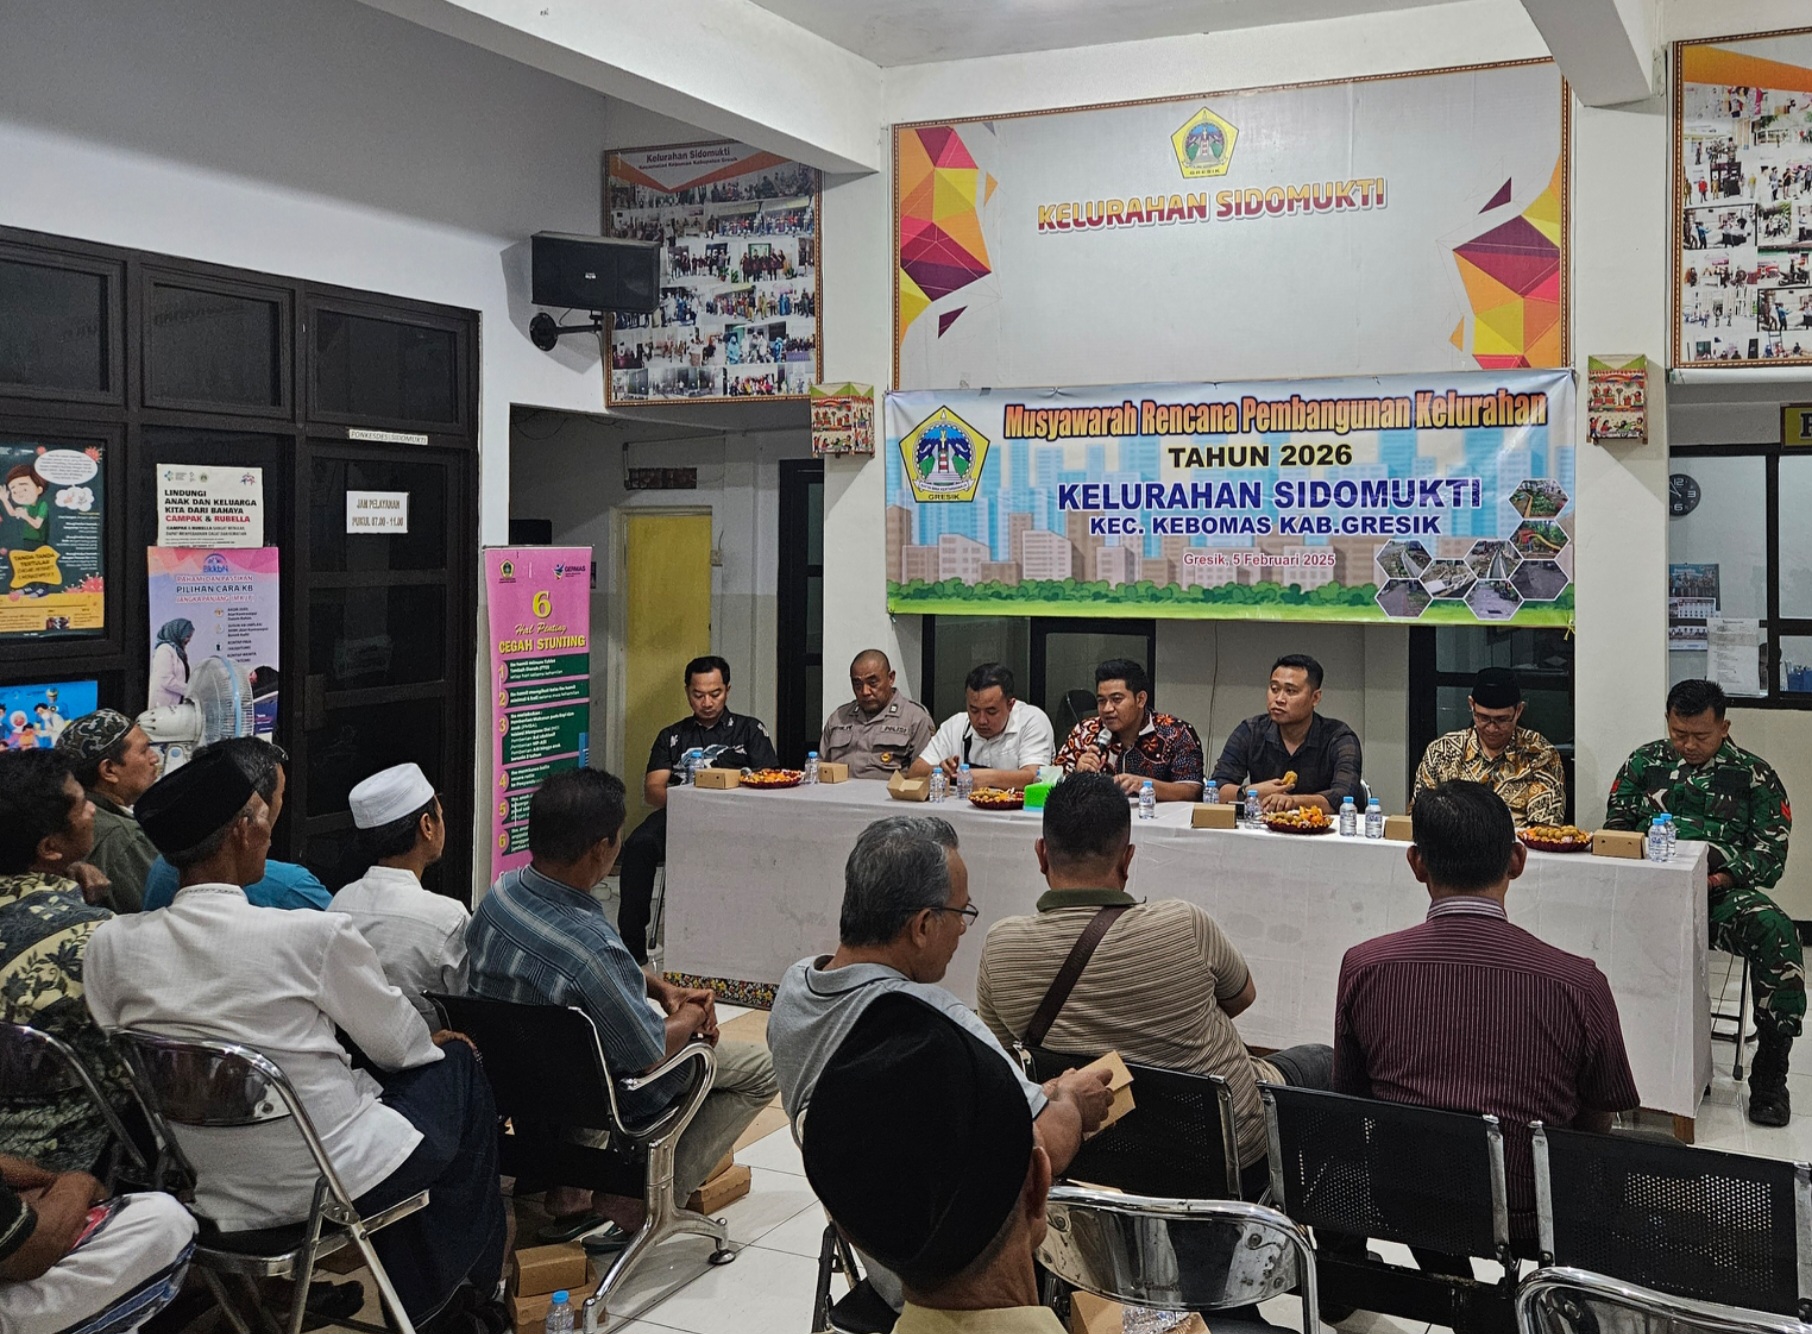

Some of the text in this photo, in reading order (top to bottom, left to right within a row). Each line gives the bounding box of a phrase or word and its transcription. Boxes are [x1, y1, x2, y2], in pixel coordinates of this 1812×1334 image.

[646, 148, 730, 164] Kelurahan Sidomukti
[1038, 177, 1386, 232] KELURAHAN SIDOMUKTI
[1004, 388, 1548, 442] Musyawarah Rencana Pembangunan Kelurahan
[1168, 444, 1352, 468] TAHUN 2026
[1673, 478, 1685, 486] 12
[1058, 478, 1481, 510] KELURAHAN SIDOMUKTI
[1687, 490, 1696, 498] 3
[357, 498, 400, 510] JAM PELAYANAN
[1674, 504, 1683, 512] 6
[1090, 515, 1441, 535] KEC. KEBOMAS KAB.GRESIK
[1183, 553, 1335, 567] Gresik, 5 Februari 2025
[242, 584, 253, 592] KB
[532, 590, 552, 619] 6
[498, 635, 587, 654] CEGAH STUNTING
[498, 664, 504, 679] 1
[498, 693, 506, 707] 2
[498, 716, 506, 733] 3
[498, 774, 506, 788] 4
[499, 802, 506, 817] 5
[498, 834, 506, 849] 6
